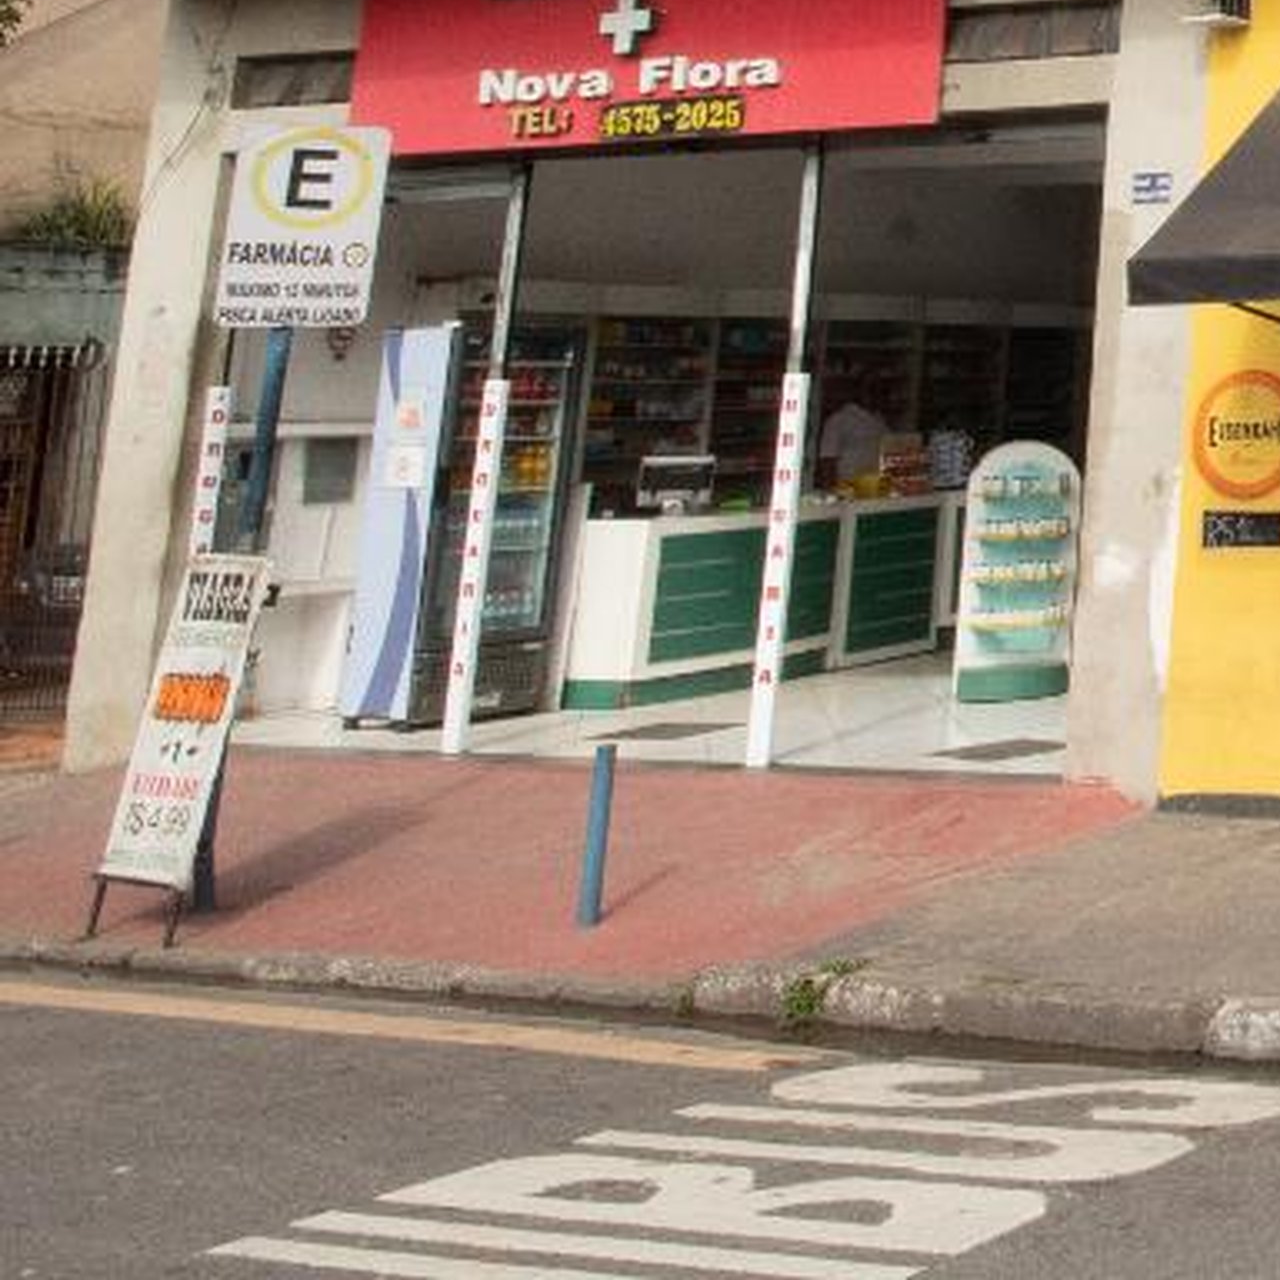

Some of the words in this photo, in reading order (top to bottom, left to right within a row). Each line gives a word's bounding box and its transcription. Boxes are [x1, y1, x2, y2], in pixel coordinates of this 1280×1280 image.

[479, 68, 613, 105] Nova
[638, 55, 780, 95] Flora
[286, 148, 340, 210] E
[228, 241, 334, 268] FARMÁCIA
